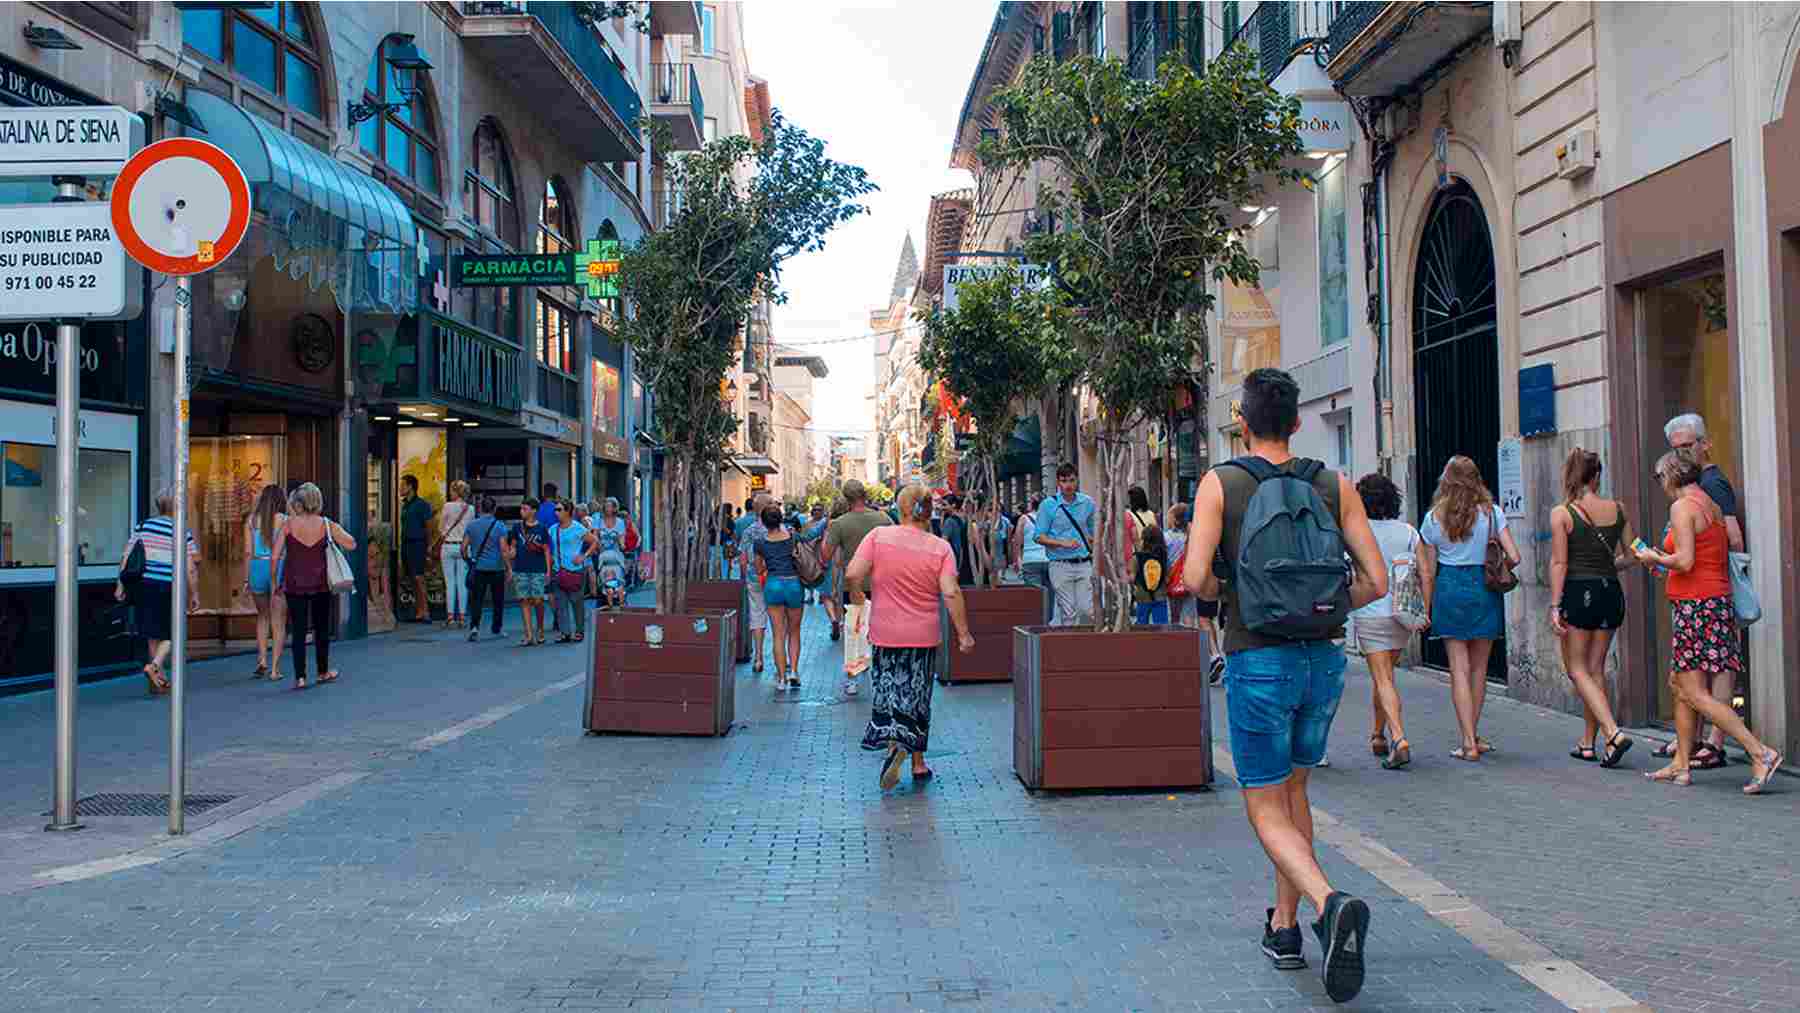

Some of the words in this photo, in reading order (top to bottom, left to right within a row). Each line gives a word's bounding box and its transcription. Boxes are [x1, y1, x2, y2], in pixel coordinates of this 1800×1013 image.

[9, 71, 27, 97] DE
[0, 119, 51, 144] TALINA
[55, 119, 75, 144] DE
[79, 119, 121, 144] SIENA
[75, 228, 111, 242] PARA
[0, 253, 18, 268] SU
[21, 251, 103, 267] PUBLICIDAD
[5, 276, 31, 290] 971
[35, 275, 53, 290] 00
[57, 275, 75, 289] 45
[78, 274, 97, 289] 22
